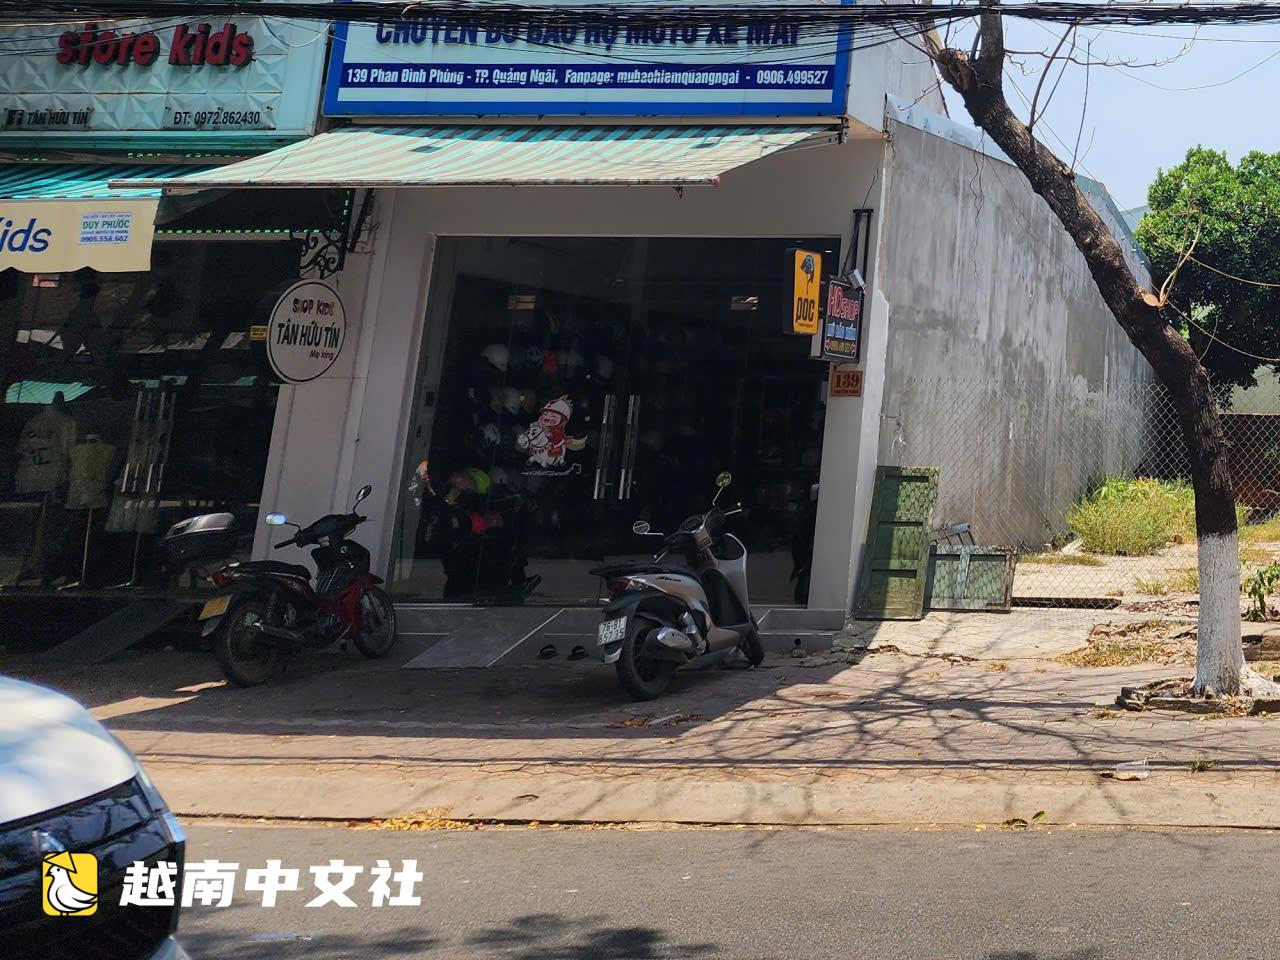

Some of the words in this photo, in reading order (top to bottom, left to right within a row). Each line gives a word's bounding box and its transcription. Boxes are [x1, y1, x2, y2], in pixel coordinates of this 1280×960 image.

[56, 23, 160, 65] store
[168, 23, 255, 65] kids
[347, 68, 368, 83] 139
[370, 68, 398, 84] Phan
[401, 67, 426, 84] Đình
[429, 67, 464, 86] Phùng
[475, 69, 489, 84] TP.
[492, 67, 527, 86] Quảng
[530, 68, 558, 86] Ngãi,
[565, 68, 614, 86] Fanpage:
[756, 69, 828, 86] 0906.499527
[173, 111, 191, 126] ĐT:
[194, 111, 260, 126] 0972.862430
[0, 217, 52, 253] ids
[82, 221, 100, 230] DUY
[276, 318, 299, 346] TÂN
[299, 320, 323, 347] HỮU
[323, 322, 340, 348] TÍN
